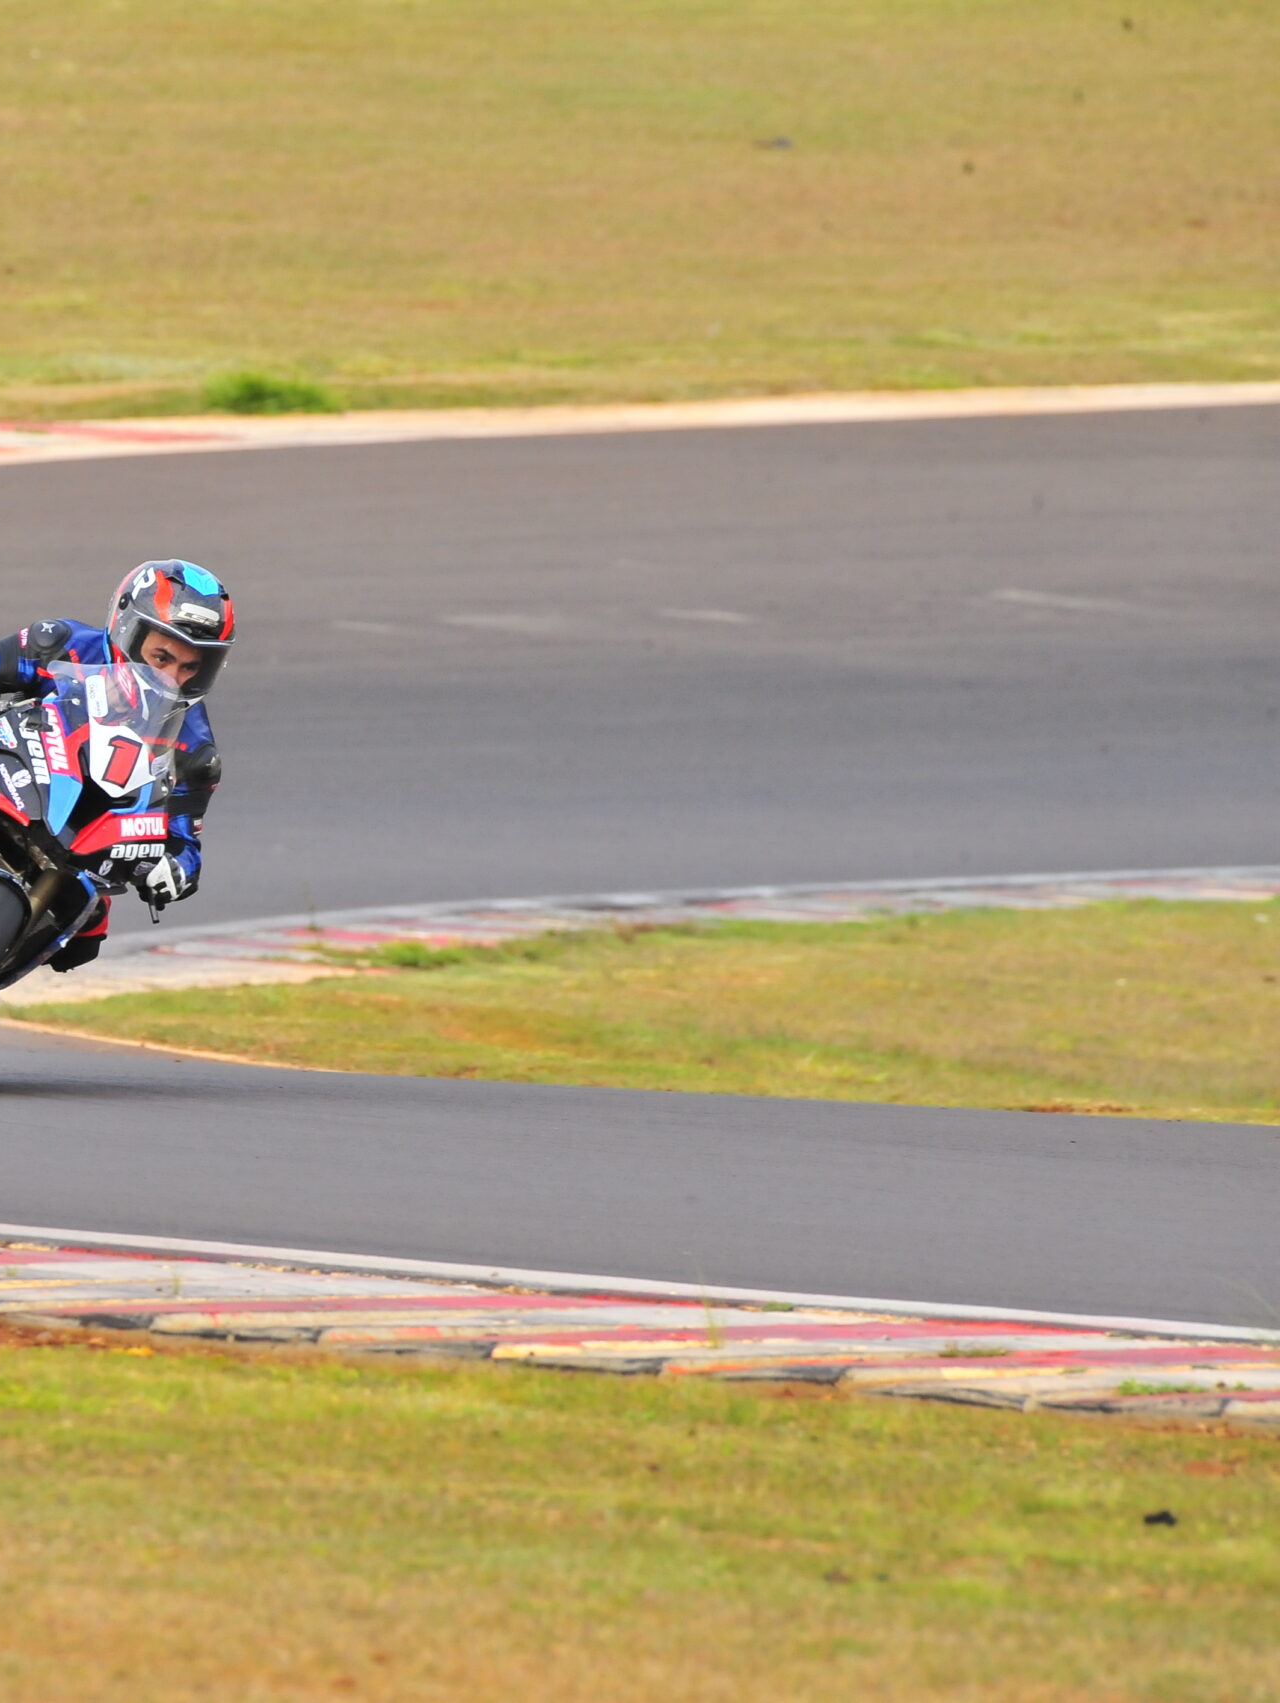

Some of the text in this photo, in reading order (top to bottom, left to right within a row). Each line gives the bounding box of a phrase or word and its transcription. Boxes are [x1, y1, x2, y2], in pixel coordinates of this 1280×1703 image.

[45, 707, 70, 772] MOTUL
[101, 734, 144, 790] 1
[120, 816, 166, 837] MOTUL
[110, 843, 166, 862] agem
